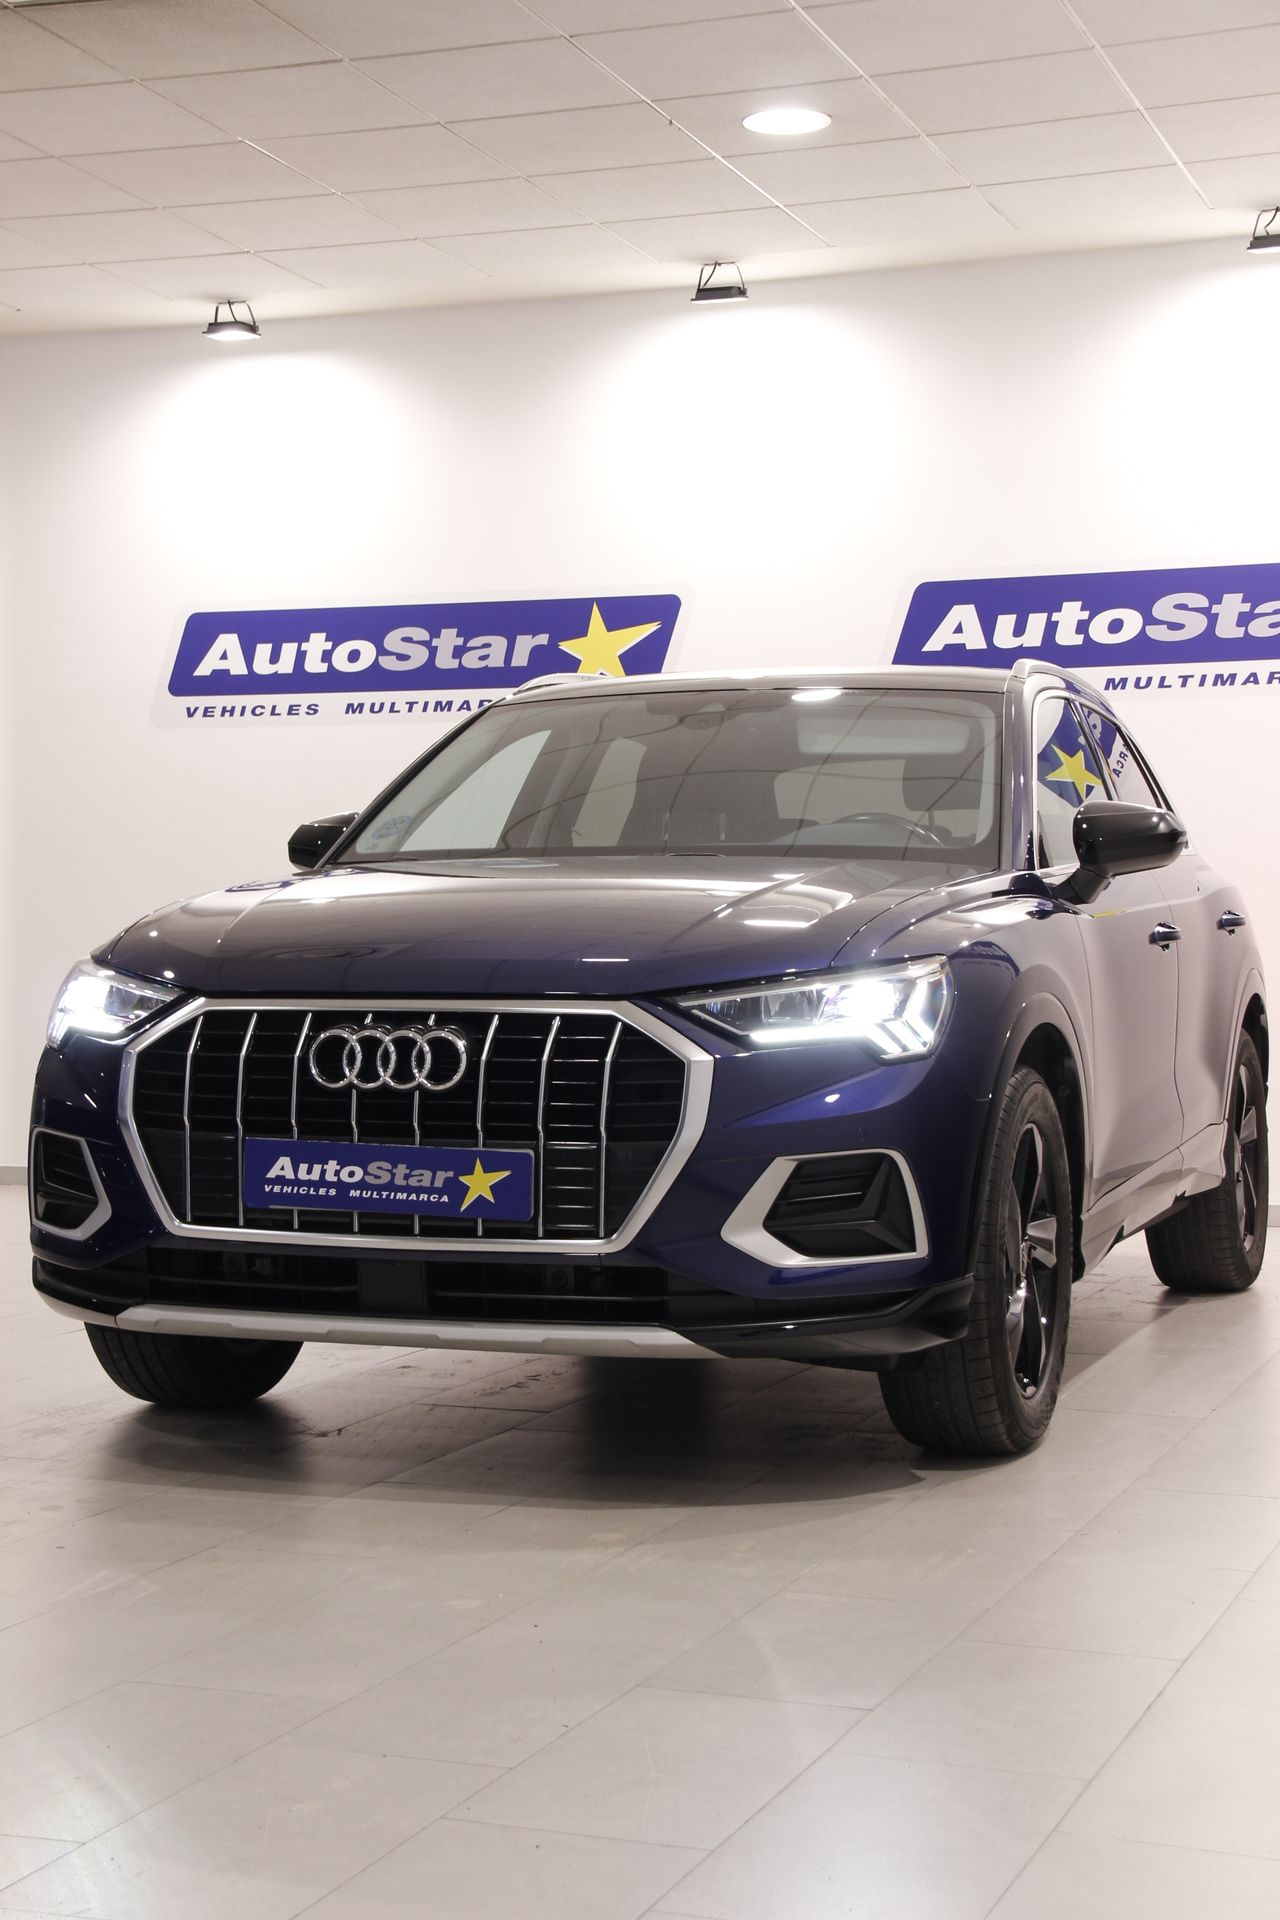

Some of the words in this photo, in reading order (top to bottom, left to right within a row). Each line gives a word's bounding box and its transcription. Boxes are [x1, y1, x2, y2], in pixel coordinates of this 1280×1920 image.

[192, 626, 549, 677] AutoStar
[186, 703, 320, 718] VEHICLES
[265, 1156, 453, 1188] AutoStar
[264, 1184, 337, 1196] VEHICLES
[349, 1189, 450, 1203] MULTIMARCA
